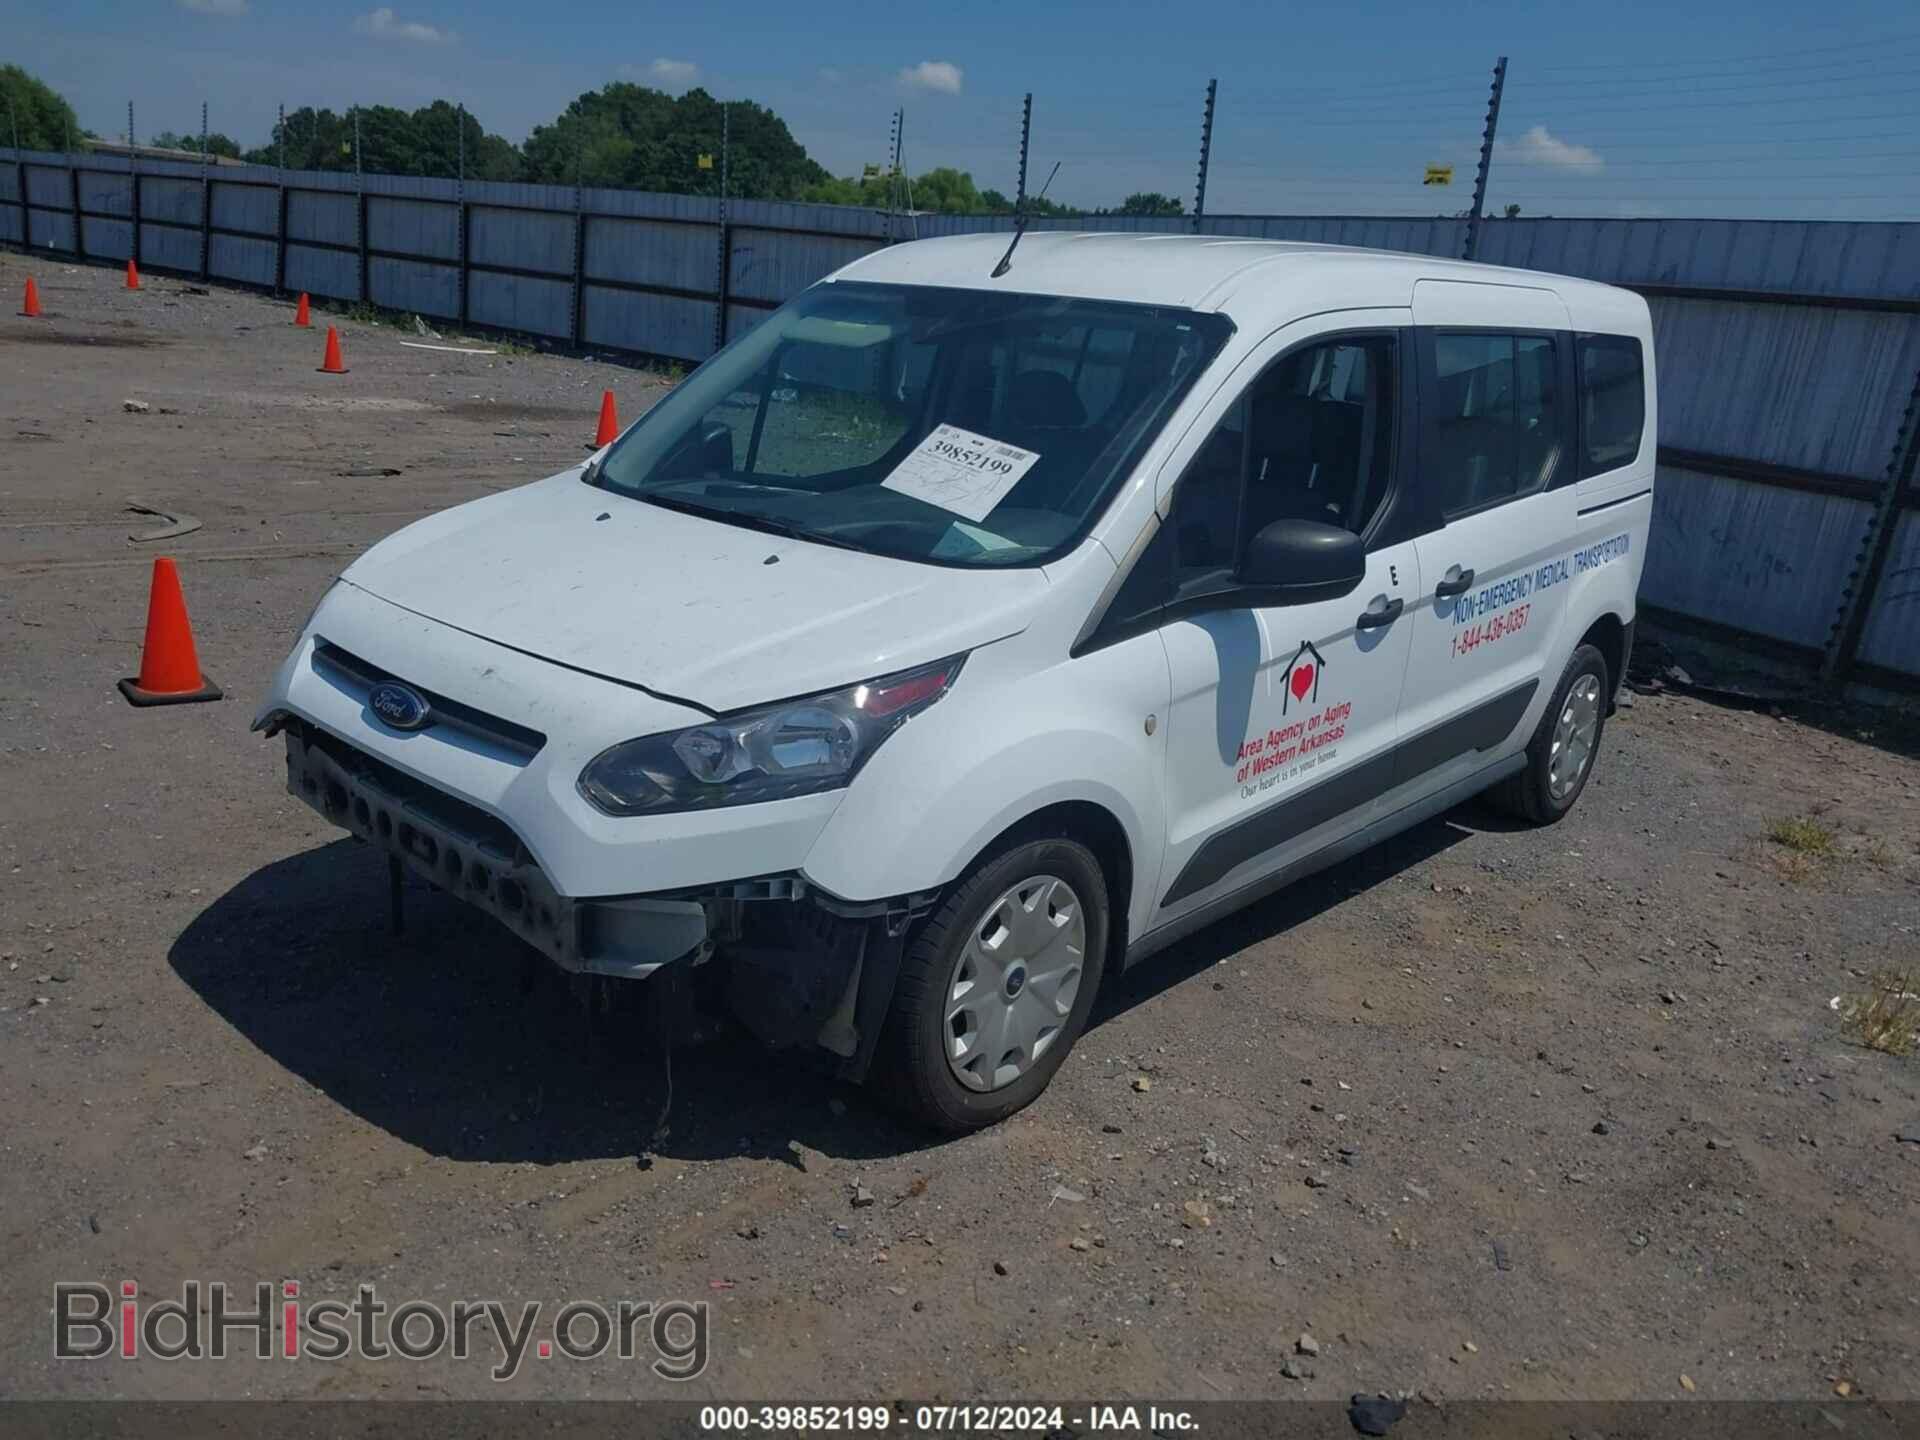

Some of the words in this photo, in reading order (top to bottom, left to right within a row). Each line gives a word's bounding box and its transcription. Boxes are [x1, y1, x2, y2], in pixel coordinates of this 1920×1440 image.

[928, 440, 1013, 475] 39852199
[1390, 565, 1399, 586] E
[1453, 573, 1533, 626] NON-EMERGENCY
[1534, 558, 1569, 591] MEDICAL
[1574, 533, 1630, 576] TRANSPORTATION
[1451, 603, 1531, 659] 1-844-436-0357
[375, 689, 407, 718] Ford
[1236, 738, 1264, 761] Area
[1265, 721, 1305, 749] Agency
[1308, 714, 1321, 731] on
[1323, 701, 1352, 726] Aging
[1237, 761, 1250, 784] of
[1252, 746, 1296, 777] Western
[1299, 725, 1345, 754] Arkansas
[1240, 784, 1257, 800] Our
[1259, 772, 1280, 791] heart
[1282, 767, 1289, 782] is
